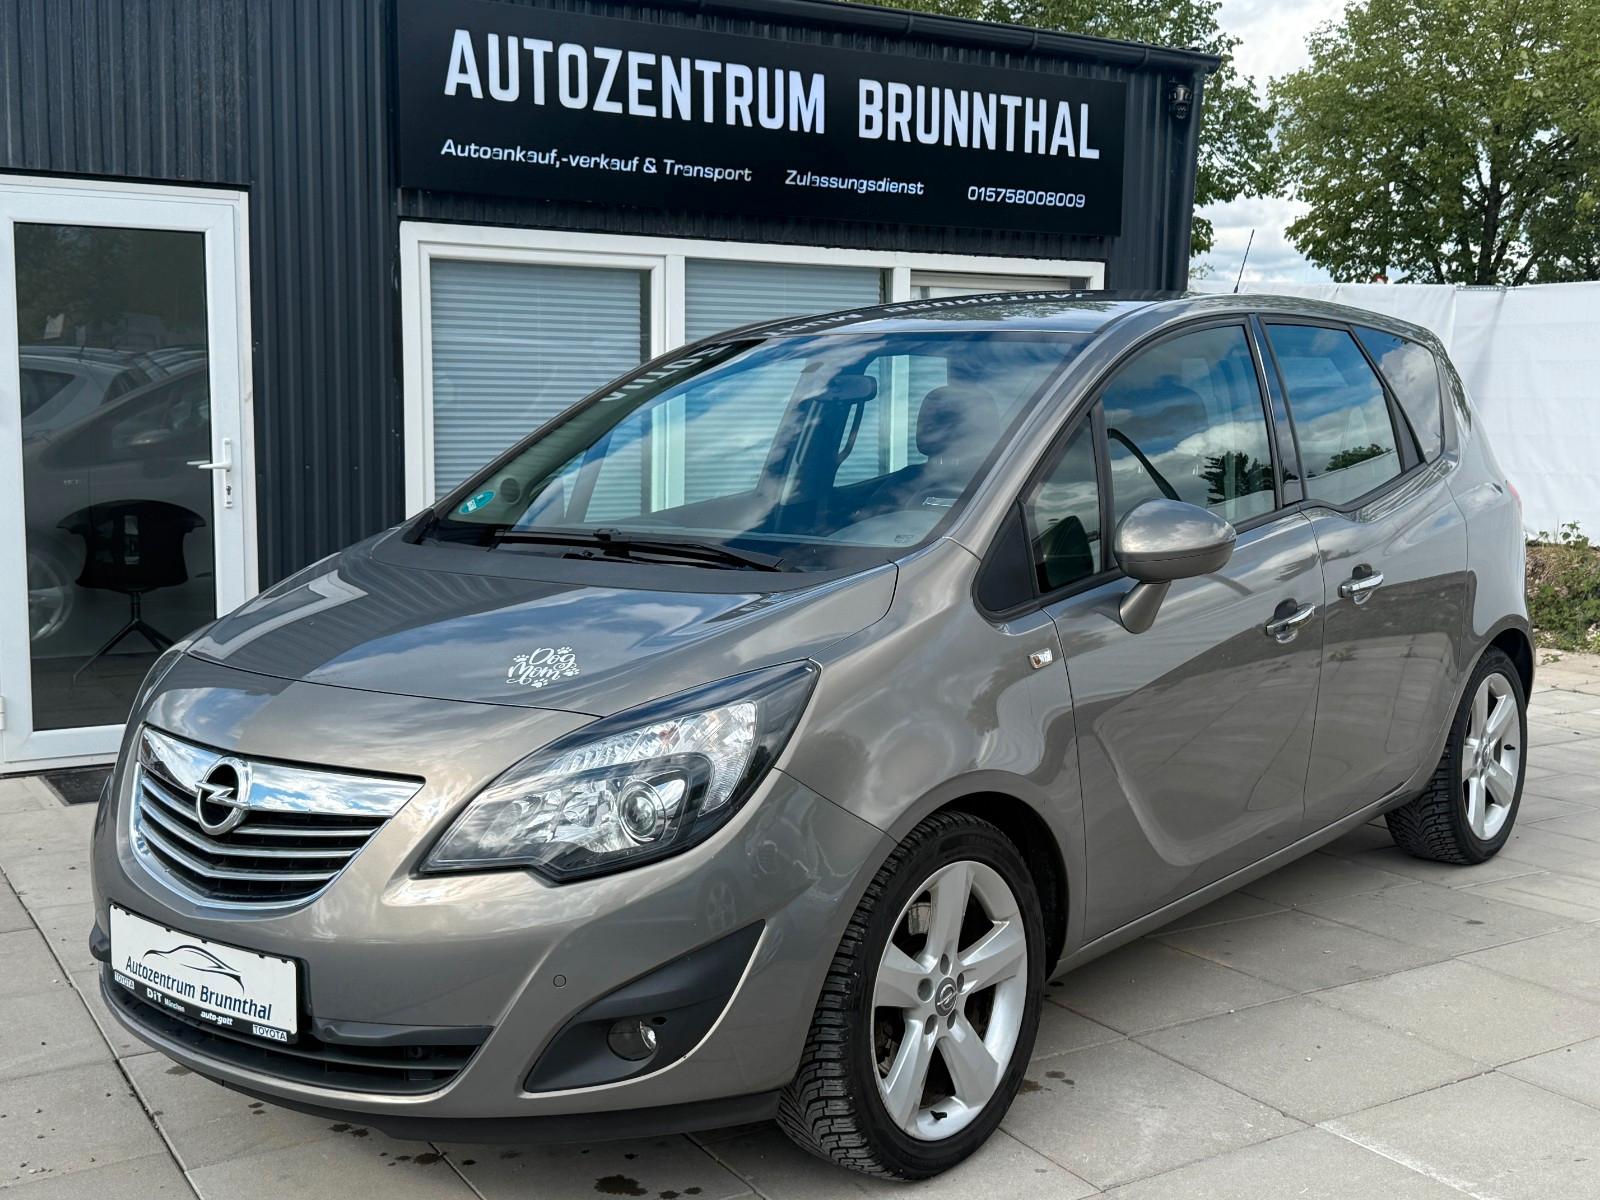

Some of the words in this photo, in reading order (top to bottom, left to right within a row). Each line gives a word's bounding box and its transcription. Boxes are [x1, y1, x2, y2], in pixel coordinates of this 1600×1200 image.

[444, 28, 825, 134] AUTOZENTRUM
[858, 78, 1100, 160] BRUNNTHAL
[440, 138, 639, 173] Autoankauf,-verkauf
[642, 157, 658, 174] &
[663, 159, 753, 182] Transport
[784, 169, 925, 195] Zulassungsdienst
[967, 185, 1086, 208] 015758008009
[506, 661, 561, 685] Mom
[125, 955, 196, 999] Autozentrum
[200, 984, 273, 1021] Brunnthal
[254, 1024, 287, 1041] TOYOTA
